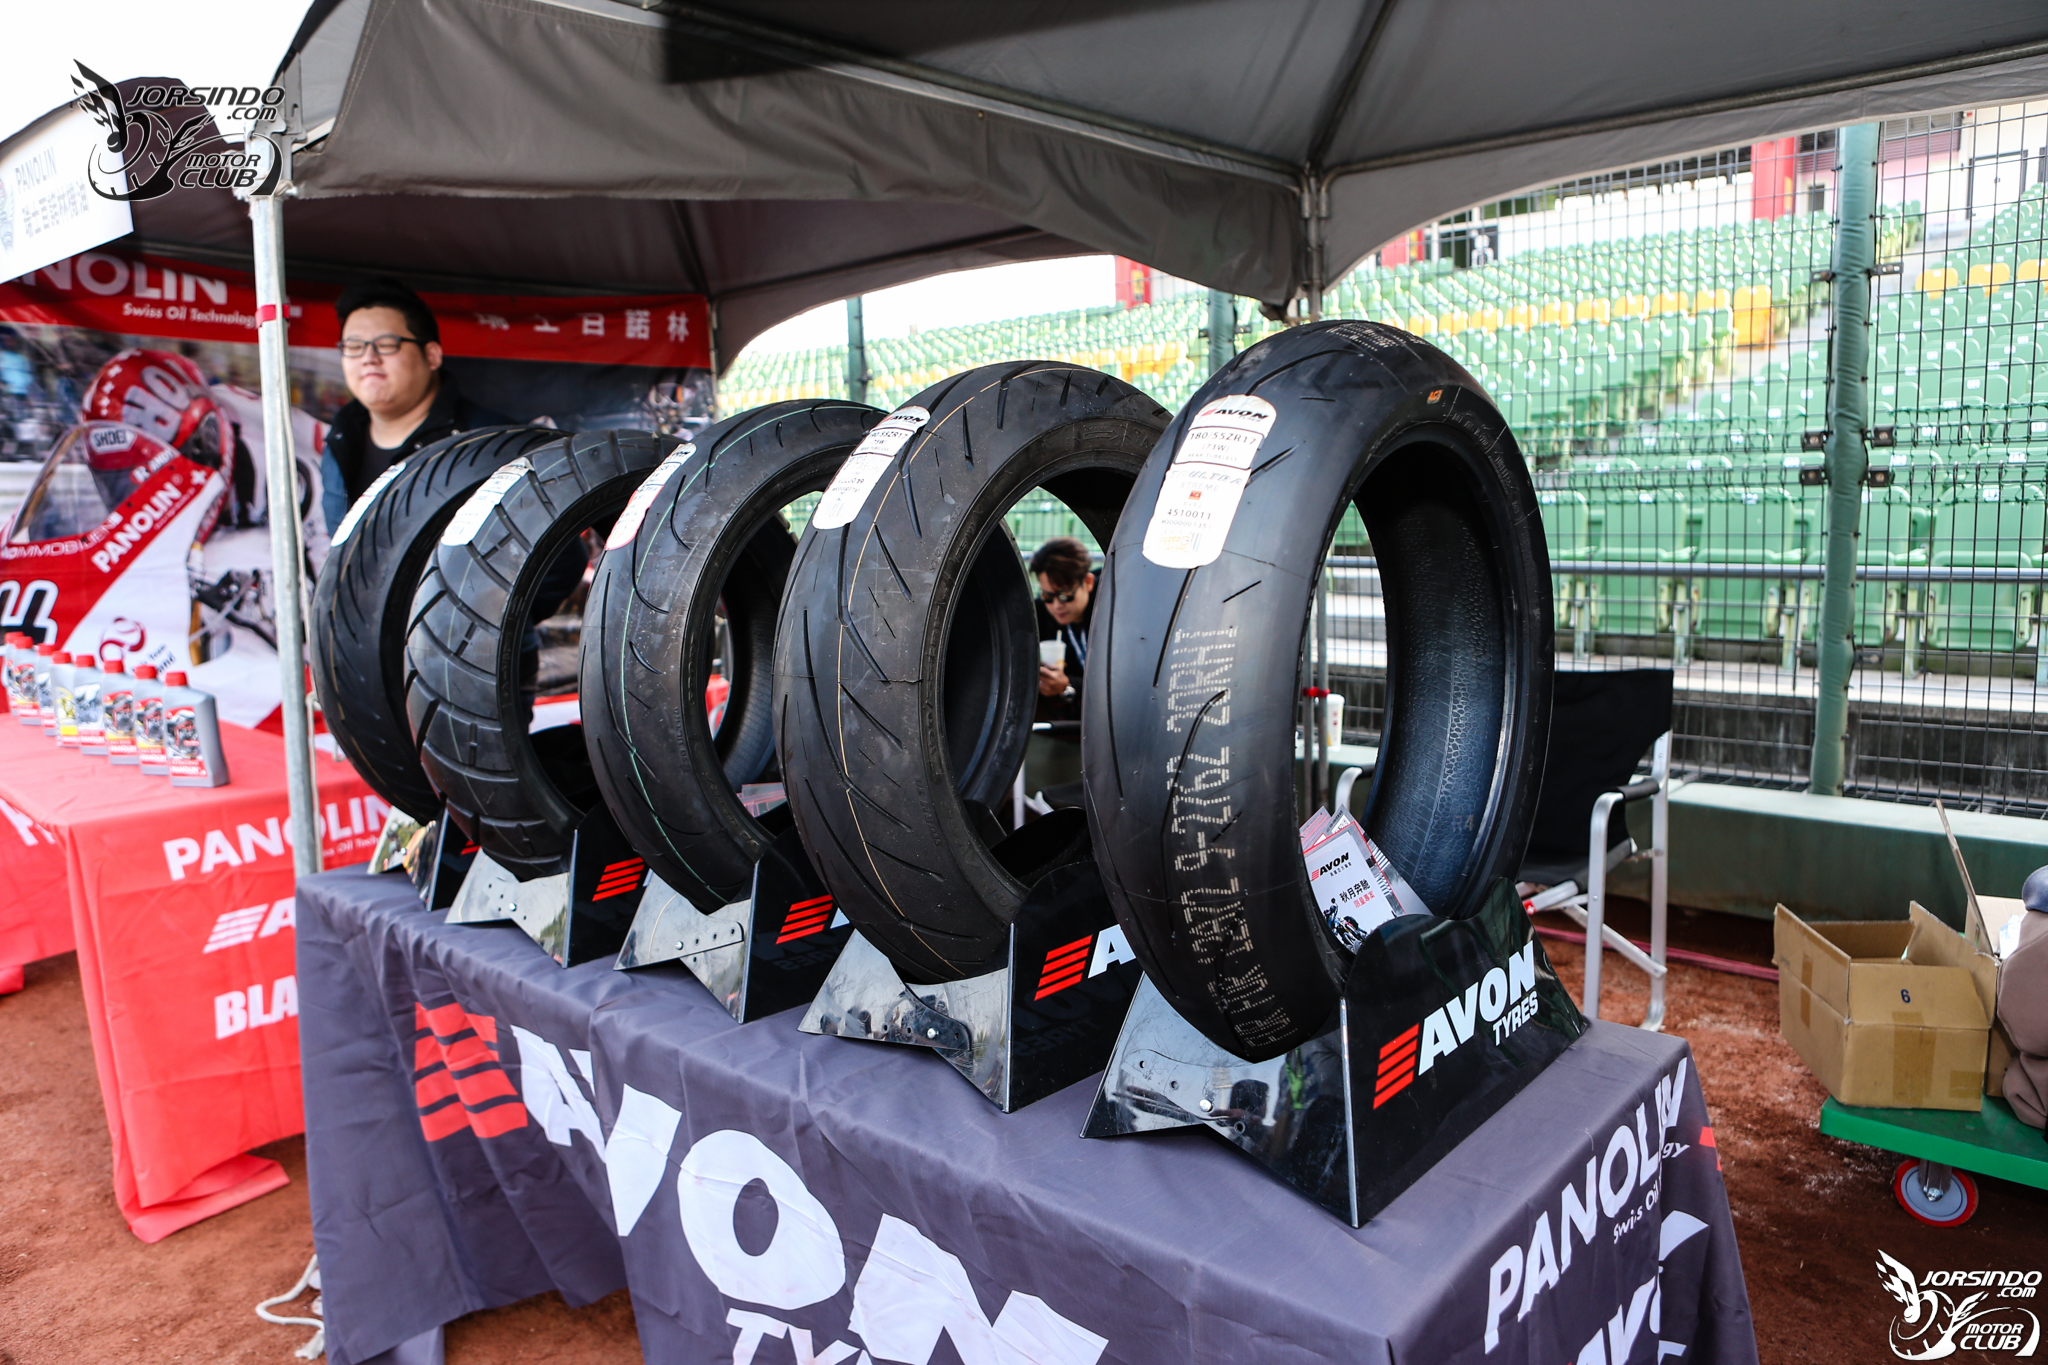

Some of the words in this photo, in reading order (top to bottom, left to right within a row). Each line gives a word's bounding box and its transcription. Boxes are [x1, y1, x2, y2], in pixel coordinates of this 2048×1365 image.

[15, 147, 57, 194] PANOLIN
[15, 252, 228, 305] NOLIN
[123, 302, 163, 319] Swiss
[166, 305, 187, 321] Oil
[190, 309, 259, 330] Technolog
[1190, 431, 1257, 445] 180/55ZR17
[1214, 408, 1269, 420] AVON
[91, 481, 183, 573] PANOLIN
[1320, 852, 1350, 876] AVON
[214, 974, 299, 1041] BLA
[1418, 940, 1536, 1076] AVON
[1492, 990, 1540, 1047] TYRES
[1900, 988, 1911, 1004] 6
[510, 1024, 1110, 1365] AVON
